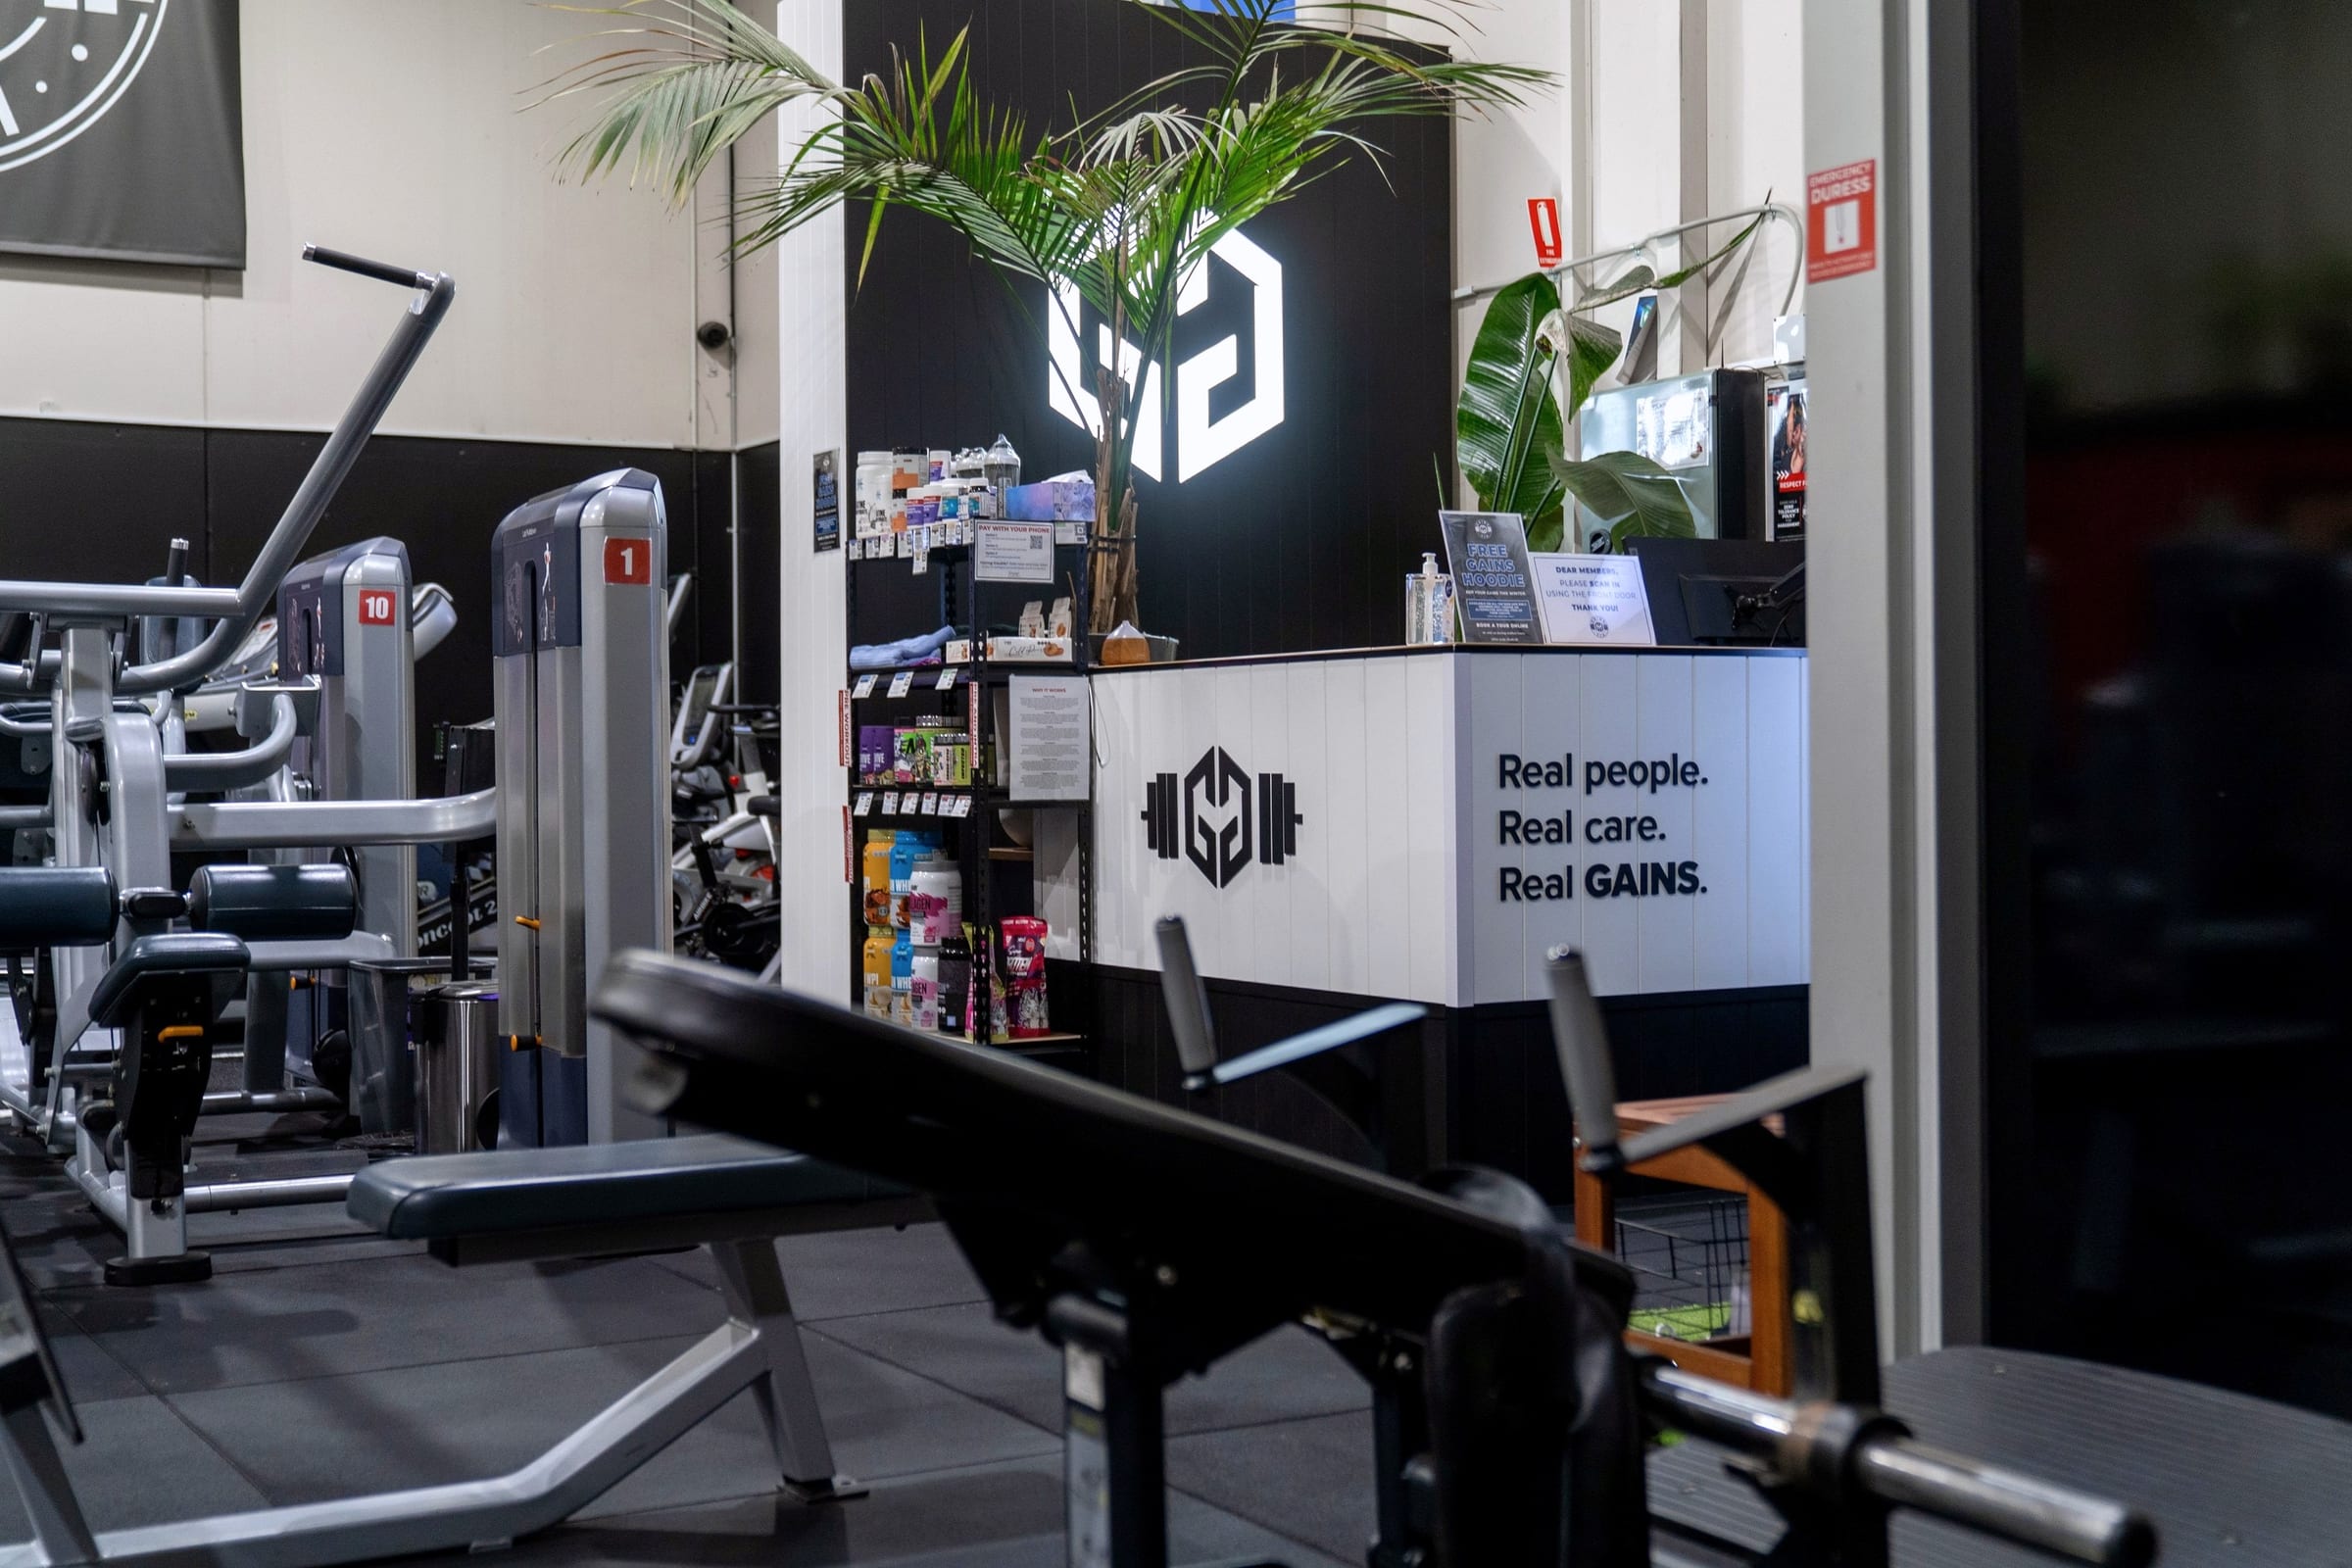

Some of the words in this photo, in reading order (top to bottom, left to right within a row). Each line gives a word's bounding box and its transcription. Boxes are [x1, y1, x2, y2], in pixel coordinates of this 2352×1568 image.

[1810, 163, 1871, 187] EMERGENCY
[1811, 175, 1872, 205] DURESS
[620, 547, 633, 576] 1
[1467, 542, 1508, 558] FREE
[1465, 559, 1515, 572] GAINS
[1461, 572, 1525, 587] HOODIE
[366, 596, 389, 619] 10
[1499, 753, 1572, 789] Real
[1586, 753, 1708, 795] people.
[1499, 809, 1572, 845] Real
[1585, 815, 1666, 844] care.
[1499, 865, 1573, 902] Real
[1585, 860, 1708, 898] GAINS.
